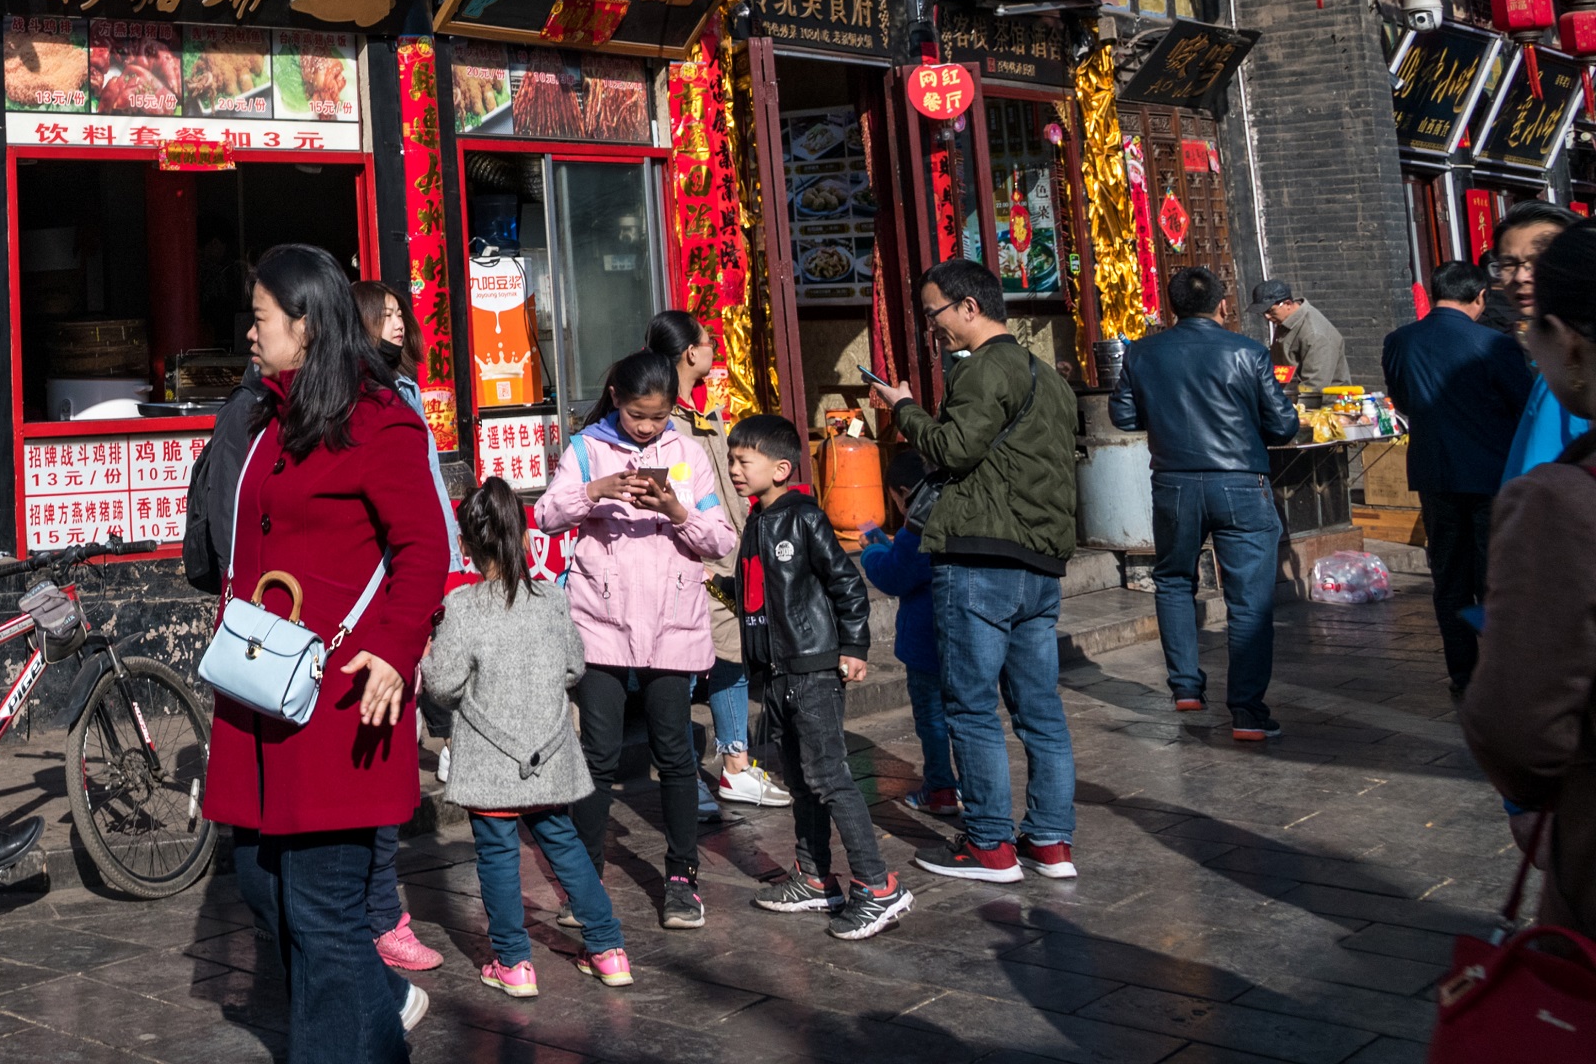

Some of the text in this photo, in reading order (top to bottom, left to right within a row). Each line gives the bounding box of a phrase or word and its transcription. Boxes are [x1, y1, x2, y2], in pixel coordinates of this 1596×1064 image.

[12, 17, 73, 35] 战斗鸡排
[99, 21, 174, 40] 方燕烤猪蹄
[466, 66, 507, 81] 20元/份
[919, 68, 961, 89] 网红
[35, 90, 86, 107] 13元/份
[128, 93, 178, 111] 15元/份
[217, 97, 267, 114] 20元/份
[308, 99, 354, 116] 15元/份
[923, 90, 962, 113] 餐厅
[1166, 207, 1182, 234] 福
[470, 274, 523, 291] 九阳豆浆
[28, 441, 123, 469] 招牌战斗鸡排
[135, 439, 206, 464] 鸡脆骨
[31, 468, 122, 487] 13元/份
[137, 465, 188, 482] 10元/
[29, 498, 124, 527] 招牌方燕烤猪蹄
[137, 496, 188, 521] 香脆鸡
[32, 524, 124, 545] 15元/份
[139, 523, 180, 538] 10元
